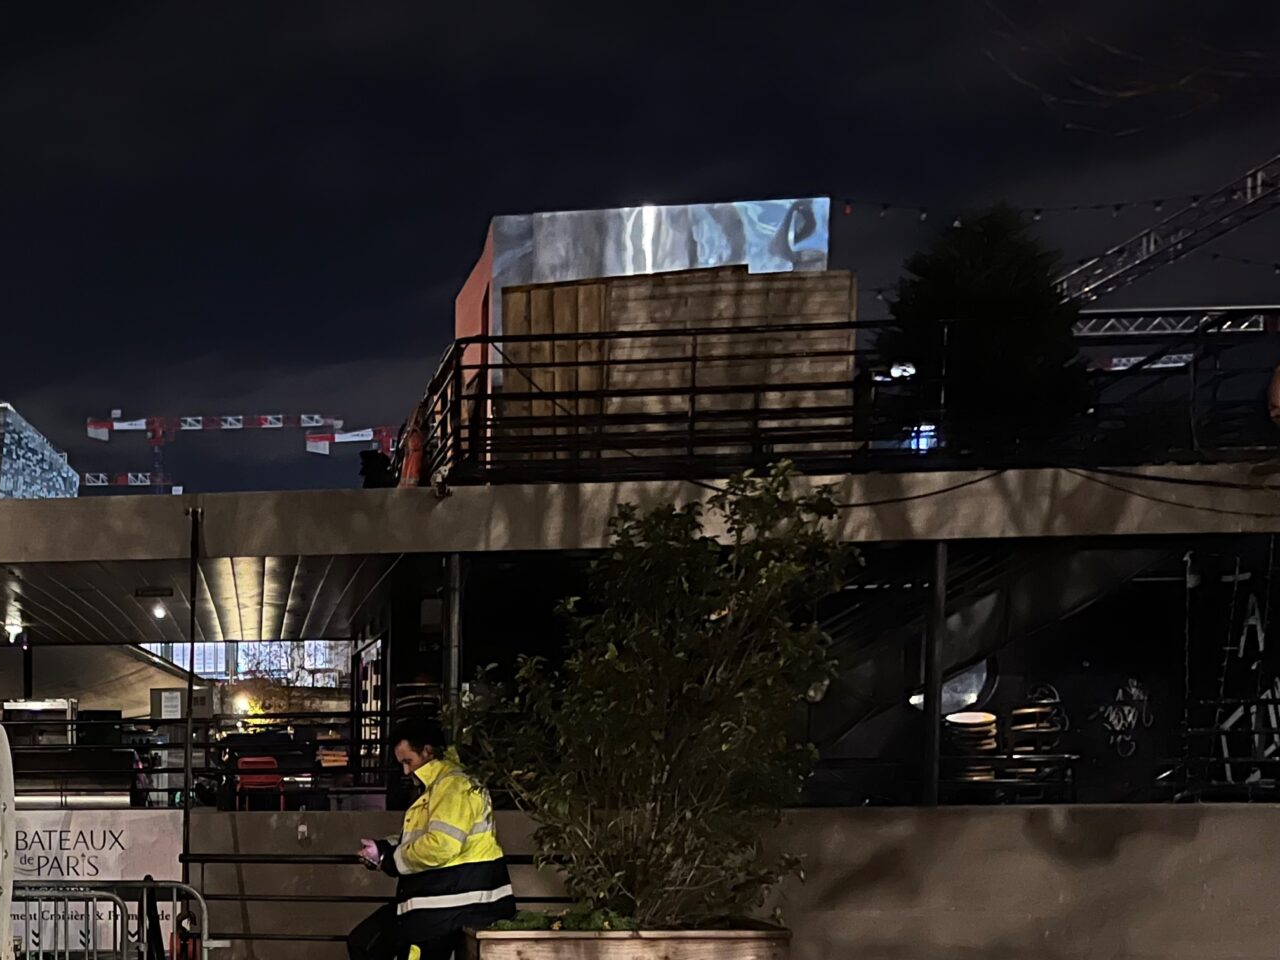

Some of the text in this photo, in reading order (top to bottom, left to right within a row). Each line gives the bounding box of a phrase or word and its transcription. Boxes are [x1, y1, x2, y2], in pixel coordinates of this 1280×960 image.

[15, 829, 126, 851] BATEAUX
[19, 853, 99, 877] de PARIS
